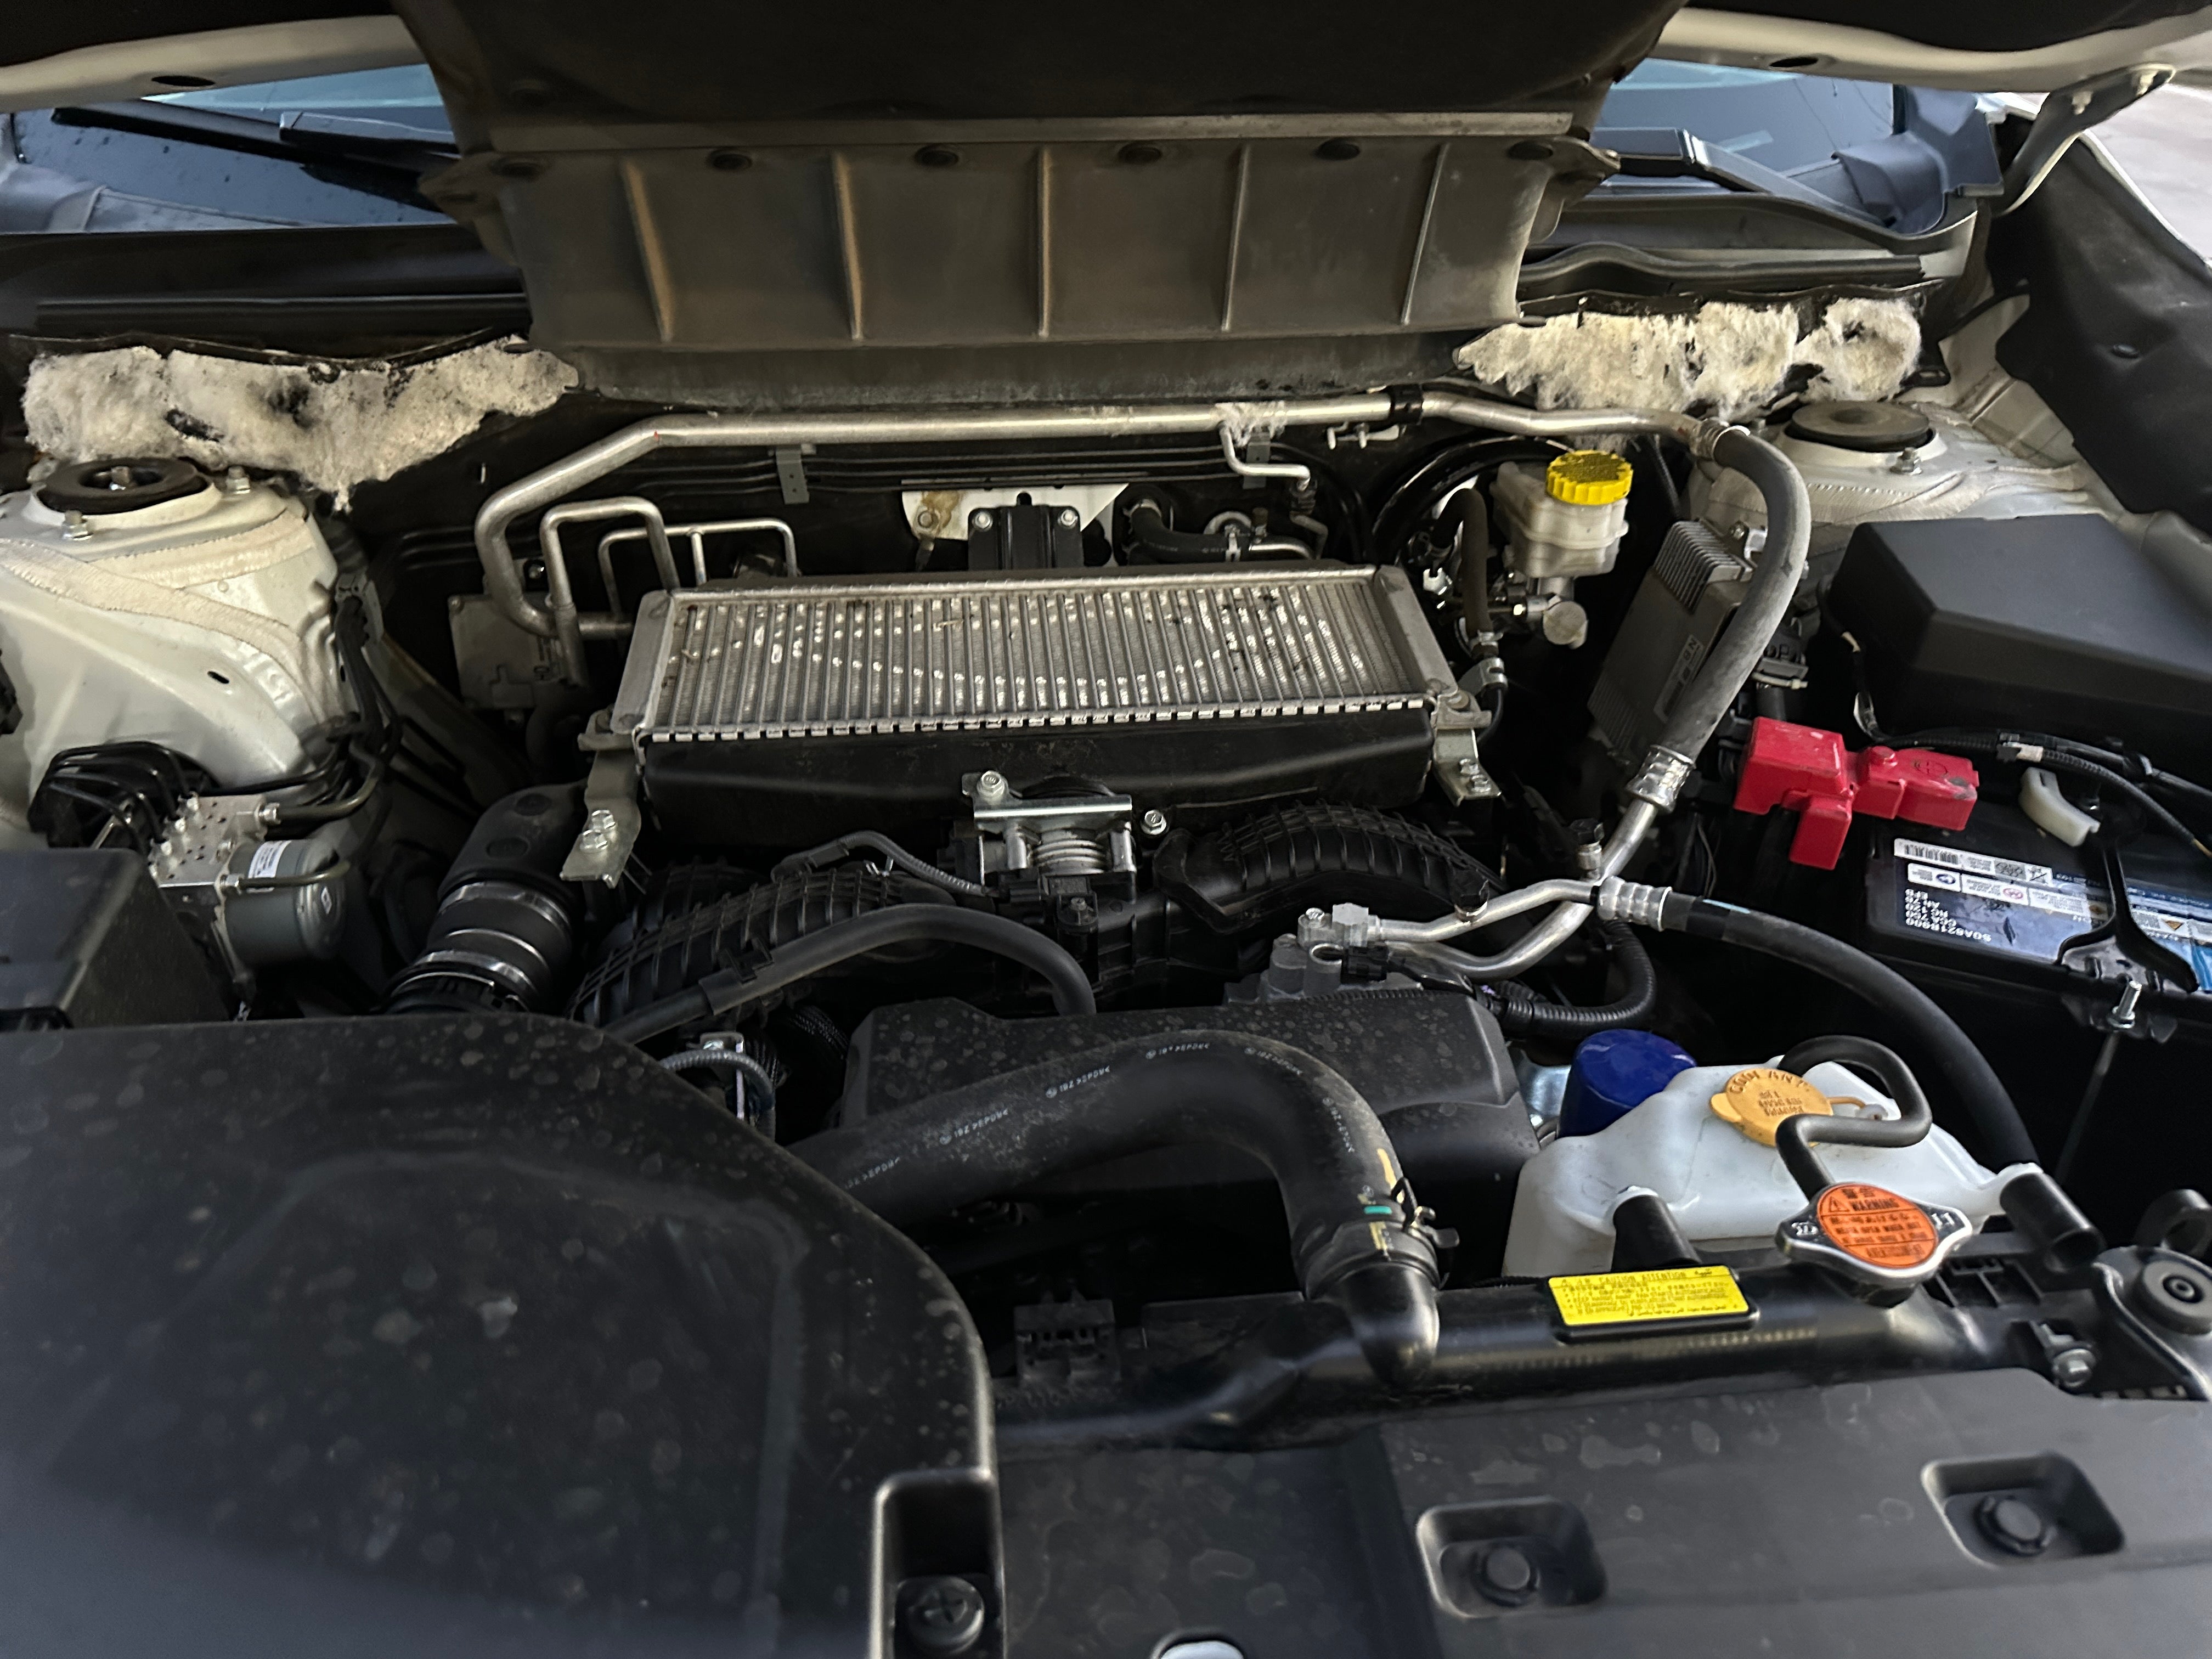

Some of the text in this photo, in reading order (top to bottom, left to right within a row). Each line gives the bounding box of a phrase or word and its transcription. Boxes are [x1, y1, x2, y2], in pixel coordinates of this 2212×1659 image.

[1849, 1198, 1900, 1211] WARNING
[1599, 1276, 1636, 1284] CAUTION
[1641, 1271, 1688, 1282] ATTENTION
